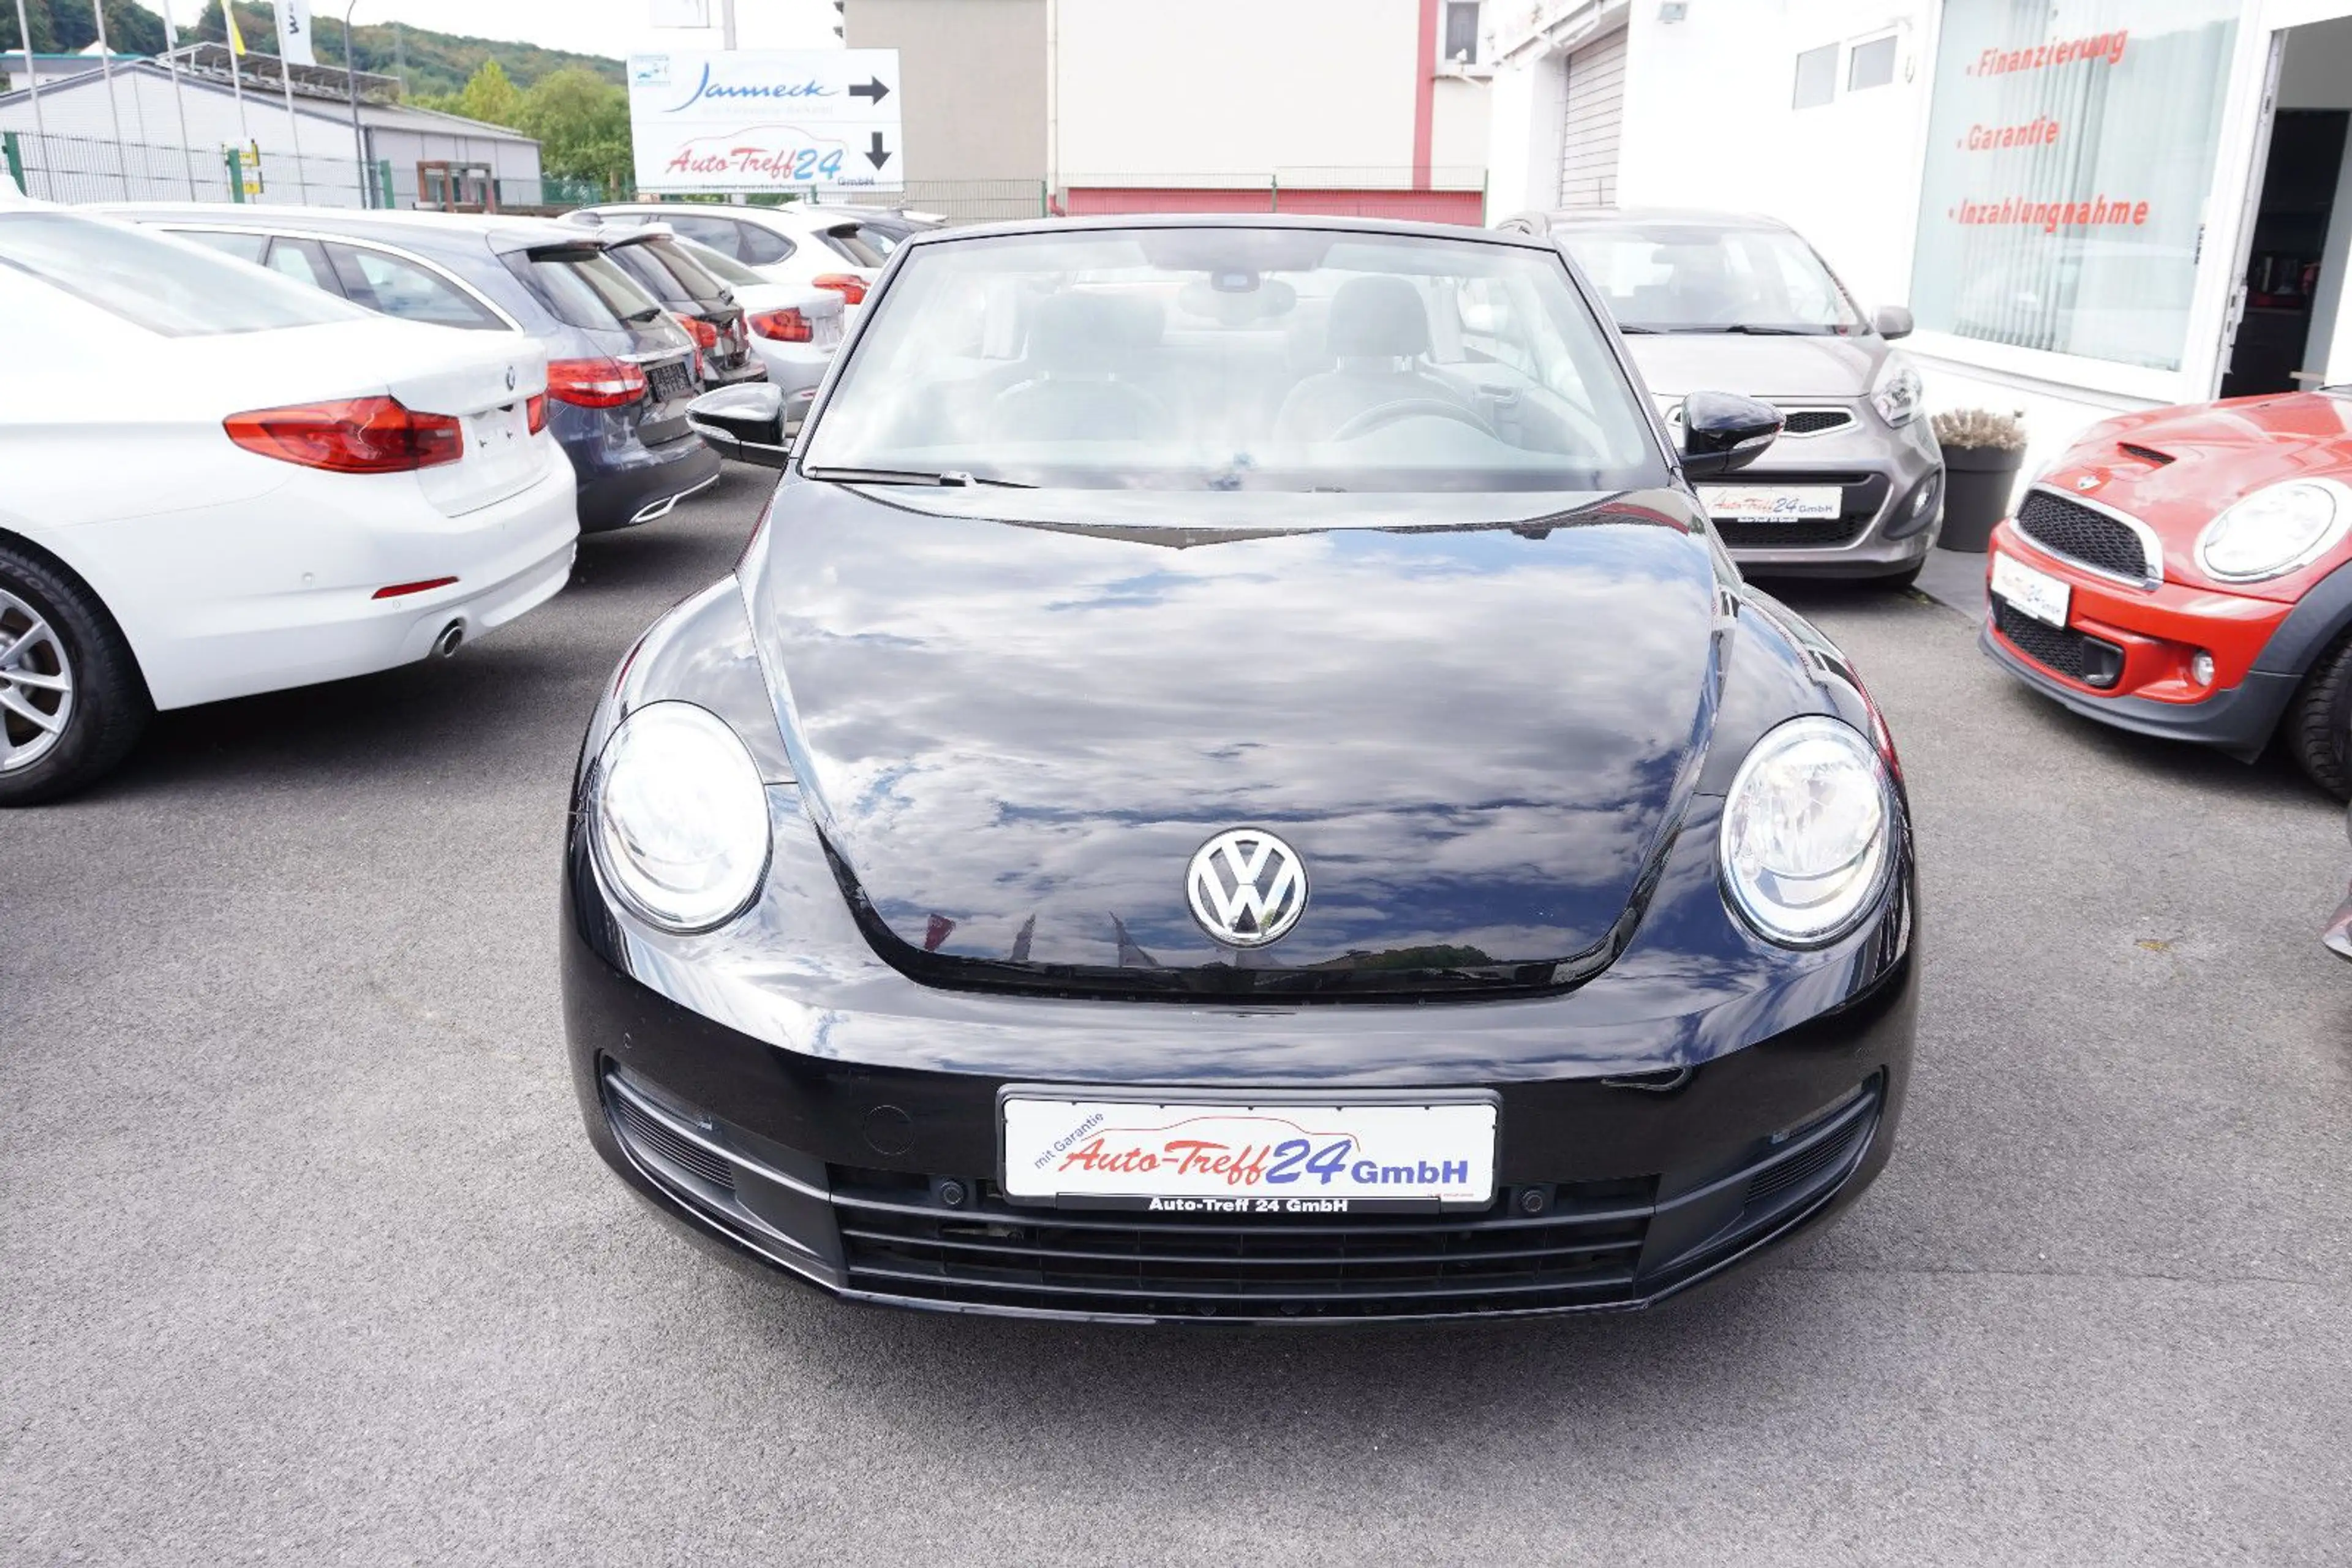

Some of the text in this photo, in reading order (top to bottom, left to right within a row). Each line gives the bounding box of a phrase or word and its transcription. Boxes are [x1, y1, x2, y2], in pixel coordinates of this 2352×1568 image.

[1977, 30, 2128, 77] Finanzierung
[1969, 115, 2059, 151] Garantie
[1959, 194, 2149, 233] Inzahlungnahme
[1034, 1112, 1104, 1169] mit Garantie
[1351, 1160, 1468, 1184] GmbH
[1148, 1197, 1348, 1212] Auto-Treff 24 GmbH
